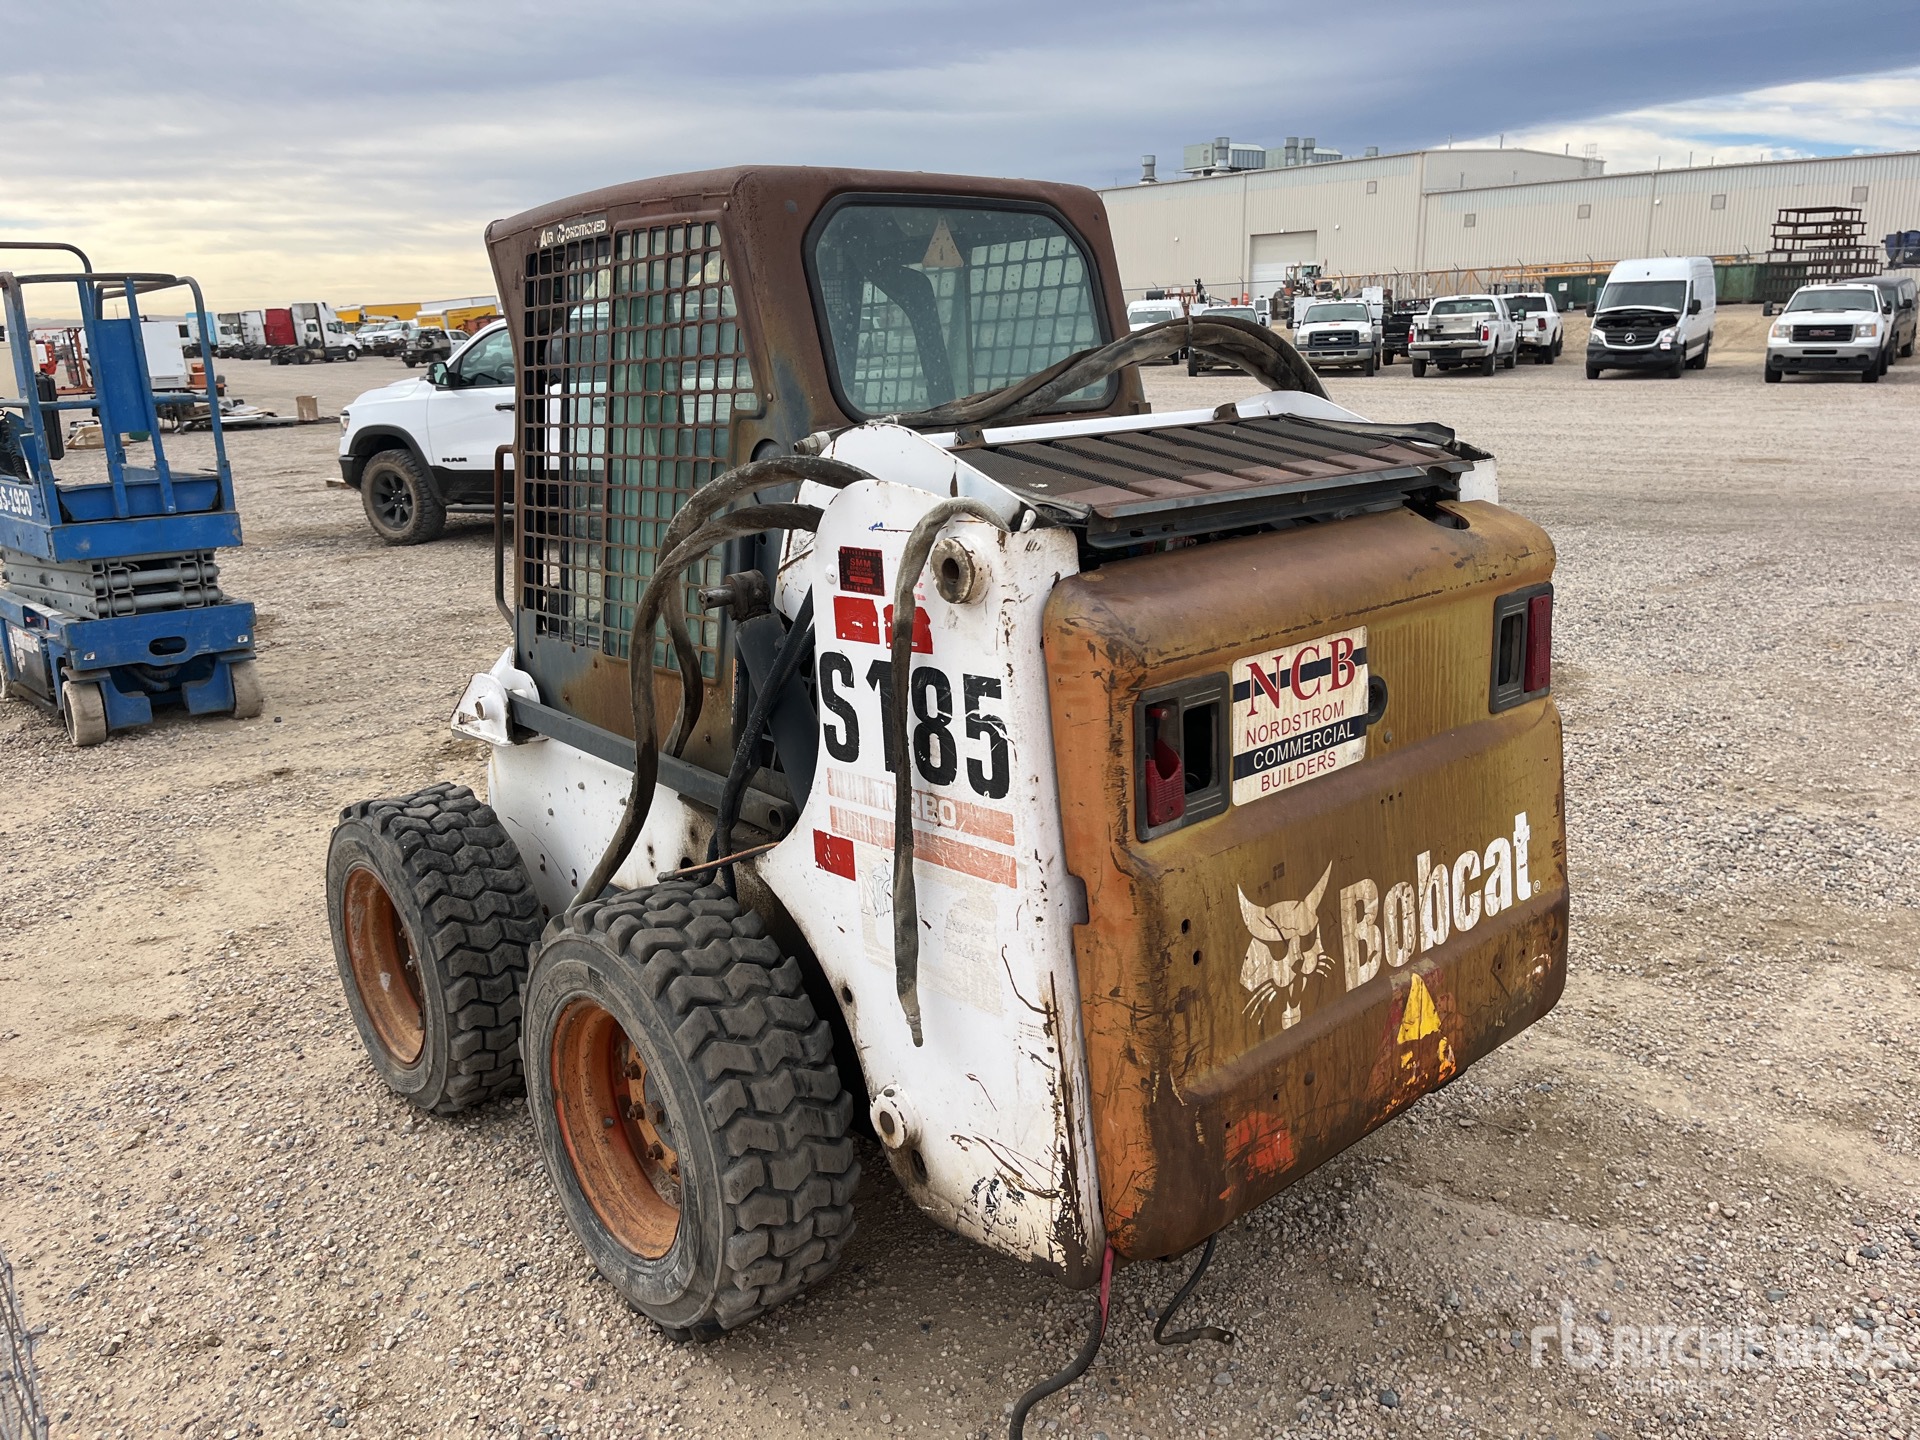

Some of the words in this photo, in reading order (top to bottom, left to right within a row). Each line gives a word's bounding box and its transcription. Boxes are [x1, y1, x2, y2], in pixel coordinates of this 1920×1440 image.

[540, 229, 554, 247] AIR
[557, 219, 606, 243] CONDITIONED
[1808, 329, 1836, 337] GMC
[850, 558, 872, 568] SMM
[1245, 636, 1356, 718] NCB
[819, 651, 1011, 800] S185
[1246, 699, 1345, 748] NORDSTROM
[1253, 721, 1355, 771] COMMERCIAL
[1261, 750, 1337, 793] BUILDERS
